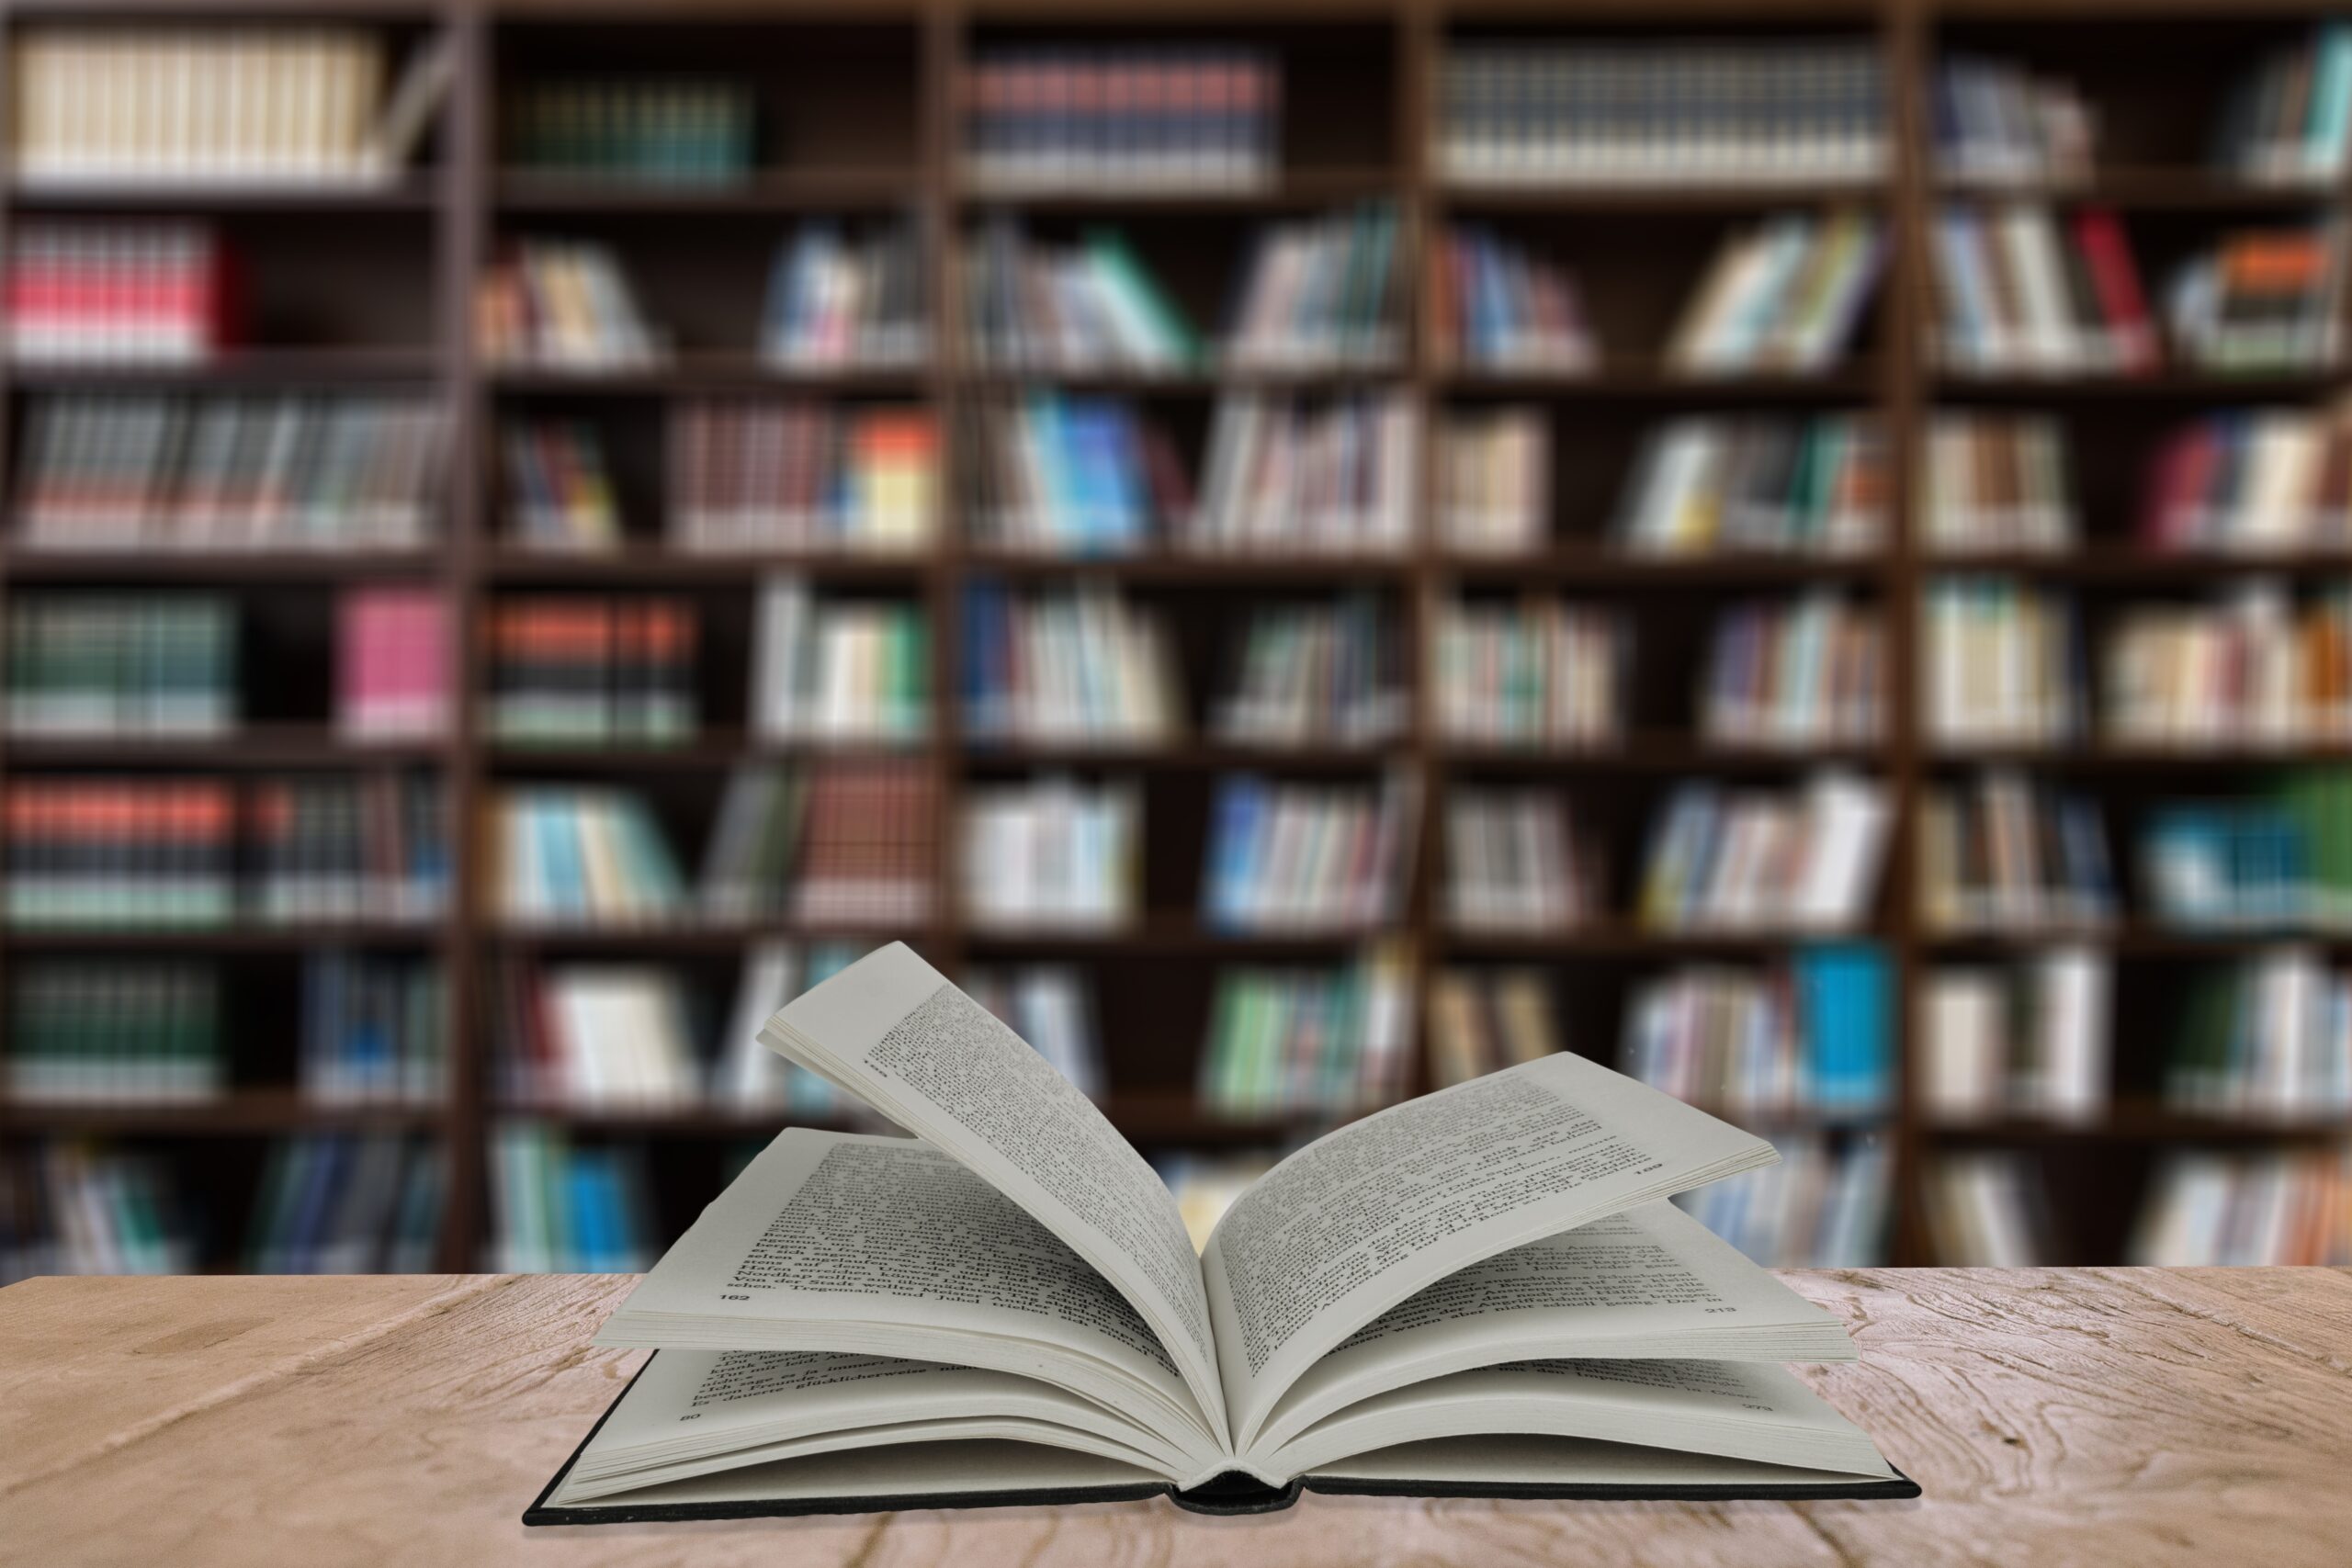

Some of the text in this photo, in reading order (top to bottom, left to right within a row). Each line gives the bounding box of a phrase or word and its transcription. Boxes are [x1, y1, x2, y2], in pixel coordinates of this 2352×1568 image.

[1445, 1223, 1472, 1235] das
[1478, 1206, 1514, 1222] Boot
[1552, 1181, 1582, 1193] Die
[878, 1266, 939, 1277] Umweg
[951, 1273, 984, 1281] über
[880, 1271, 933, 1280] können.
[736, 1270, 812, 1279] Nordkap
[898, 1278, 1000, 1295] übernächsten
[1008, 1292, 1038, 1303] Tag
[922, 1286, 982, 1298] Meister
[991, 1294, 1049, 1310] Antifer
[788, 1284, 879, 1293] Tregomain
[935, 1293, 979, 1303] Juhel
[992, 1302, 1048, 1314] trieben
[1060, 1315, 1088, 1326] sich
[1324, 1333, 1383, 1357] atrosen
[1392, 1318, 1441, 1333] waren
[1450, 1309, 1486, 1318] aber
[1352, 1324, 1390, 1337] Boot
[1401, 1314, 1427, 1324] aus
[709, 1360, 756, 1374] krank
[763, 1353, 819, 1364] werden
[785, 1358, 818, 1366] leid,
[721, 1387, 784, 1401] dauerte
[795, 1368, 926, 1389] glücklicherweise
[740, 1377, 774, 1385] sage
[693, 1388, 742, 1400] besten
